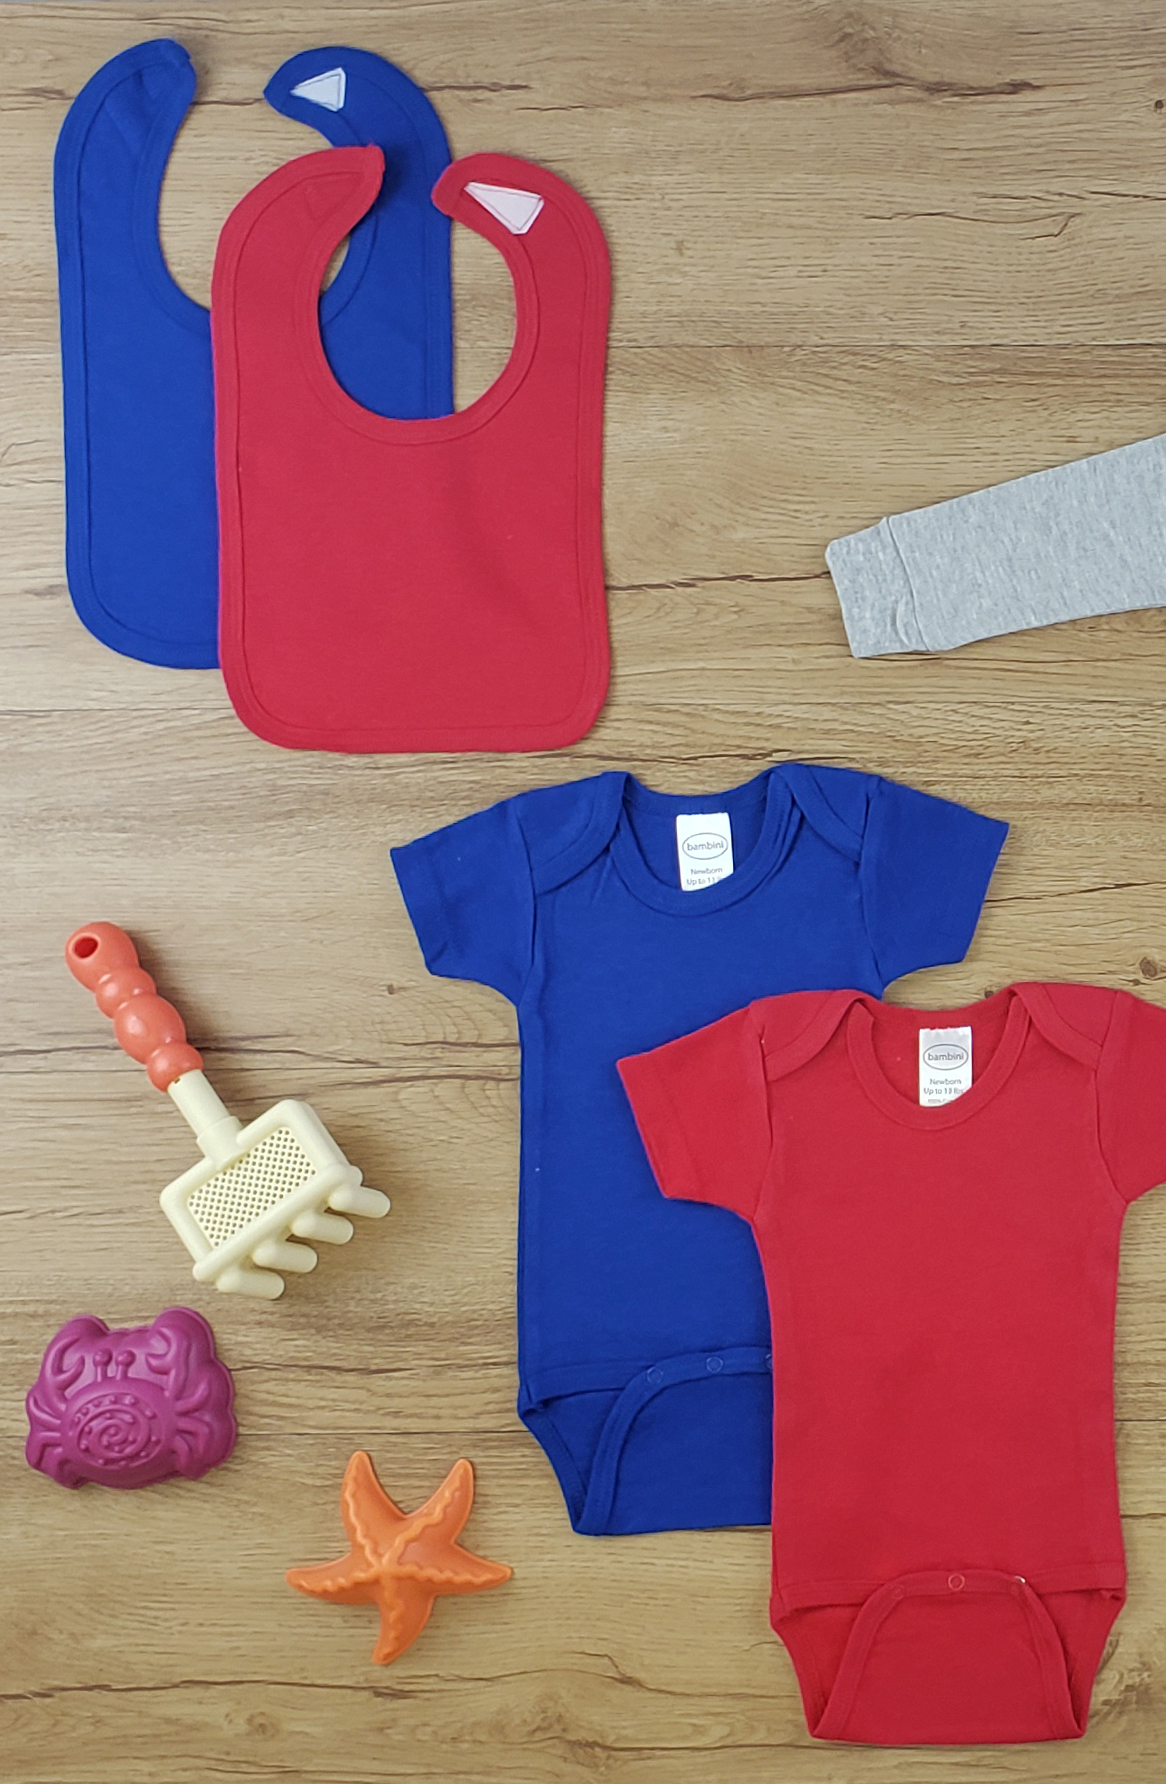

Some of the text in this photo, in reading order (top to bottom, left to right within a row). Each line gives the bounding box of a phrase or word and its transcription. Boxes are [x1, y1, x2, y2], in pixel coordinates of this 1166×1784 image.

[686, 840, 724, 851] bambini
[690, 867, 723, 875] Newborn
[686, 878, 697, 886] Up
[927, 1051, 965, 1061] bambini
[929, 1077, 962, 1085] Newborn
[923, 1087, 934, 1096] Up
[935, 1087, 943, 1095] to
